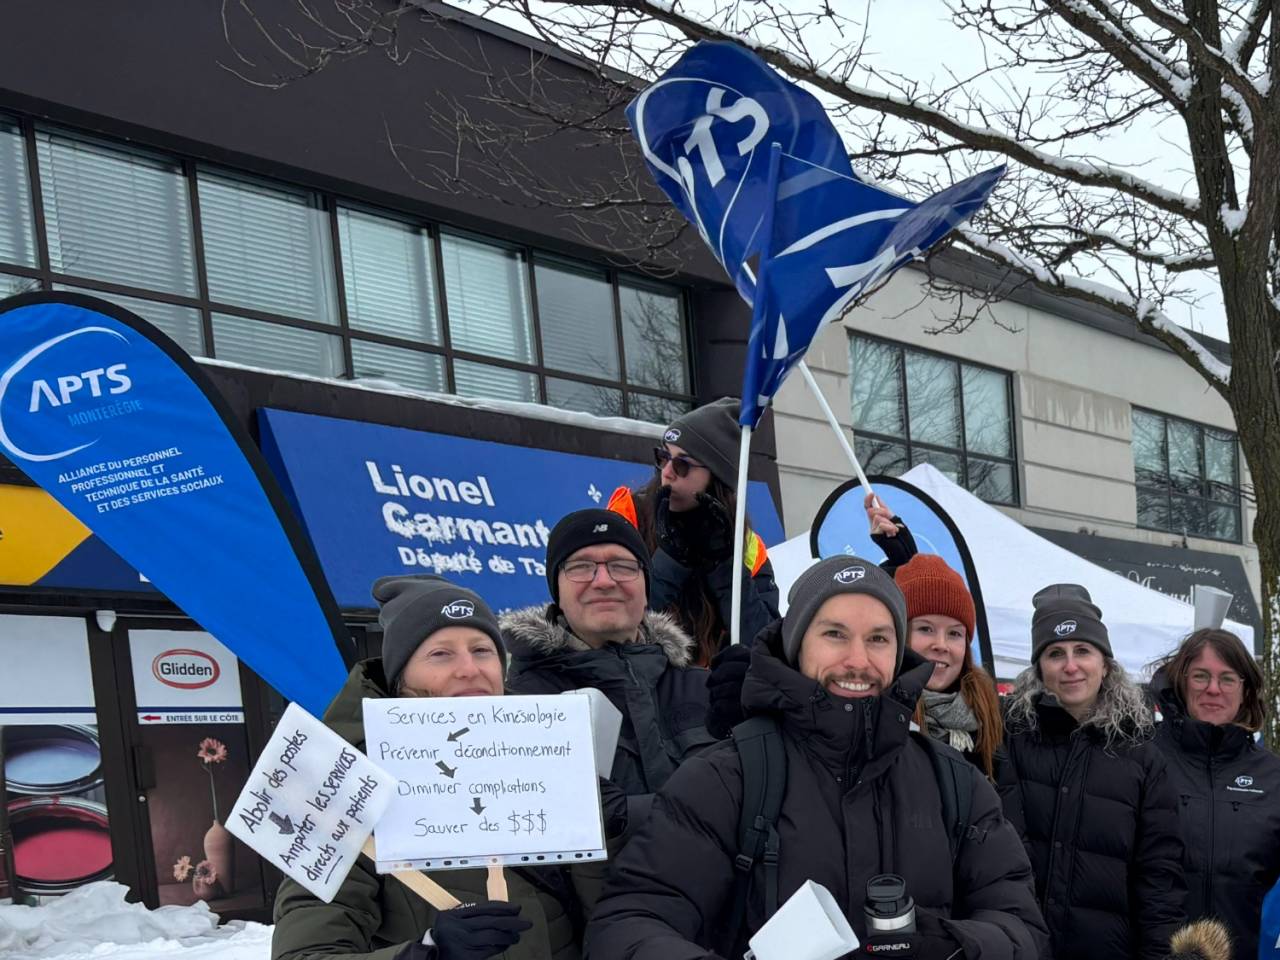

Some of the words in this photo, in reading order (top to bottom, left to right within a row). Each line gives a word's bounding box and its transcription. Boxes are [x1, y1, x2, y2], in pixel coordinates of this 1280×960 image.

[29, 363, 132, 413] APTS
[58, 463, 107, 484] ALLIANCE
[108, 460, 122, 471] DU
[123, 447, 183, 468] PERSONNEL
[71, 468, 151, 494] PROFESSIONNEL
[152, 464, 165, 475] ET
[85, 481, 139, 503] TECHNIQUE
[141, 479, 153, 490] DE
[154, 476, 170, 486] LA
[170, 465, 205, 483] SANTÉ
[365, 461, 495, 507] Lionel
[97, 503, 110, 514] ET
[111, 498, 131, 511] DES
[132, 486, 180, 504] SERVICES
[181, 475, 224, 494] SOCIAUX
[488, 555, 516, 574] de
[518, 557, 548, 577] Ta
[834, 570, 865, 581] APTS
[441, 605, 474, 617] APTS
[160, 662, 213, 676] Glidden
[209, 714, 218, 722] LE
[387, 705, 457, 725] Services
[468, 714, 486, 725] en
[379, 741, 440, 761] Prévenir
[454, 740, 572, 759] déconditionnement
[239, 788, 273, 834] Abolir
[262, 768, 288, 789] des
[280, 729, 308, 772] postes
[397, 780, 462, 796] Diminuer
[279, 813, 316, 868] Amputer
[305, 790, 331, 812] les
[301, 843, 337, 881] directs
[332, 819, 350, 842] aux
[346, 775, 378, 824] patients
[414, 818, 469, 837] Sauver
[479, 816, 500, 832] des
[872, 942, 911, 952] GARNEAU
